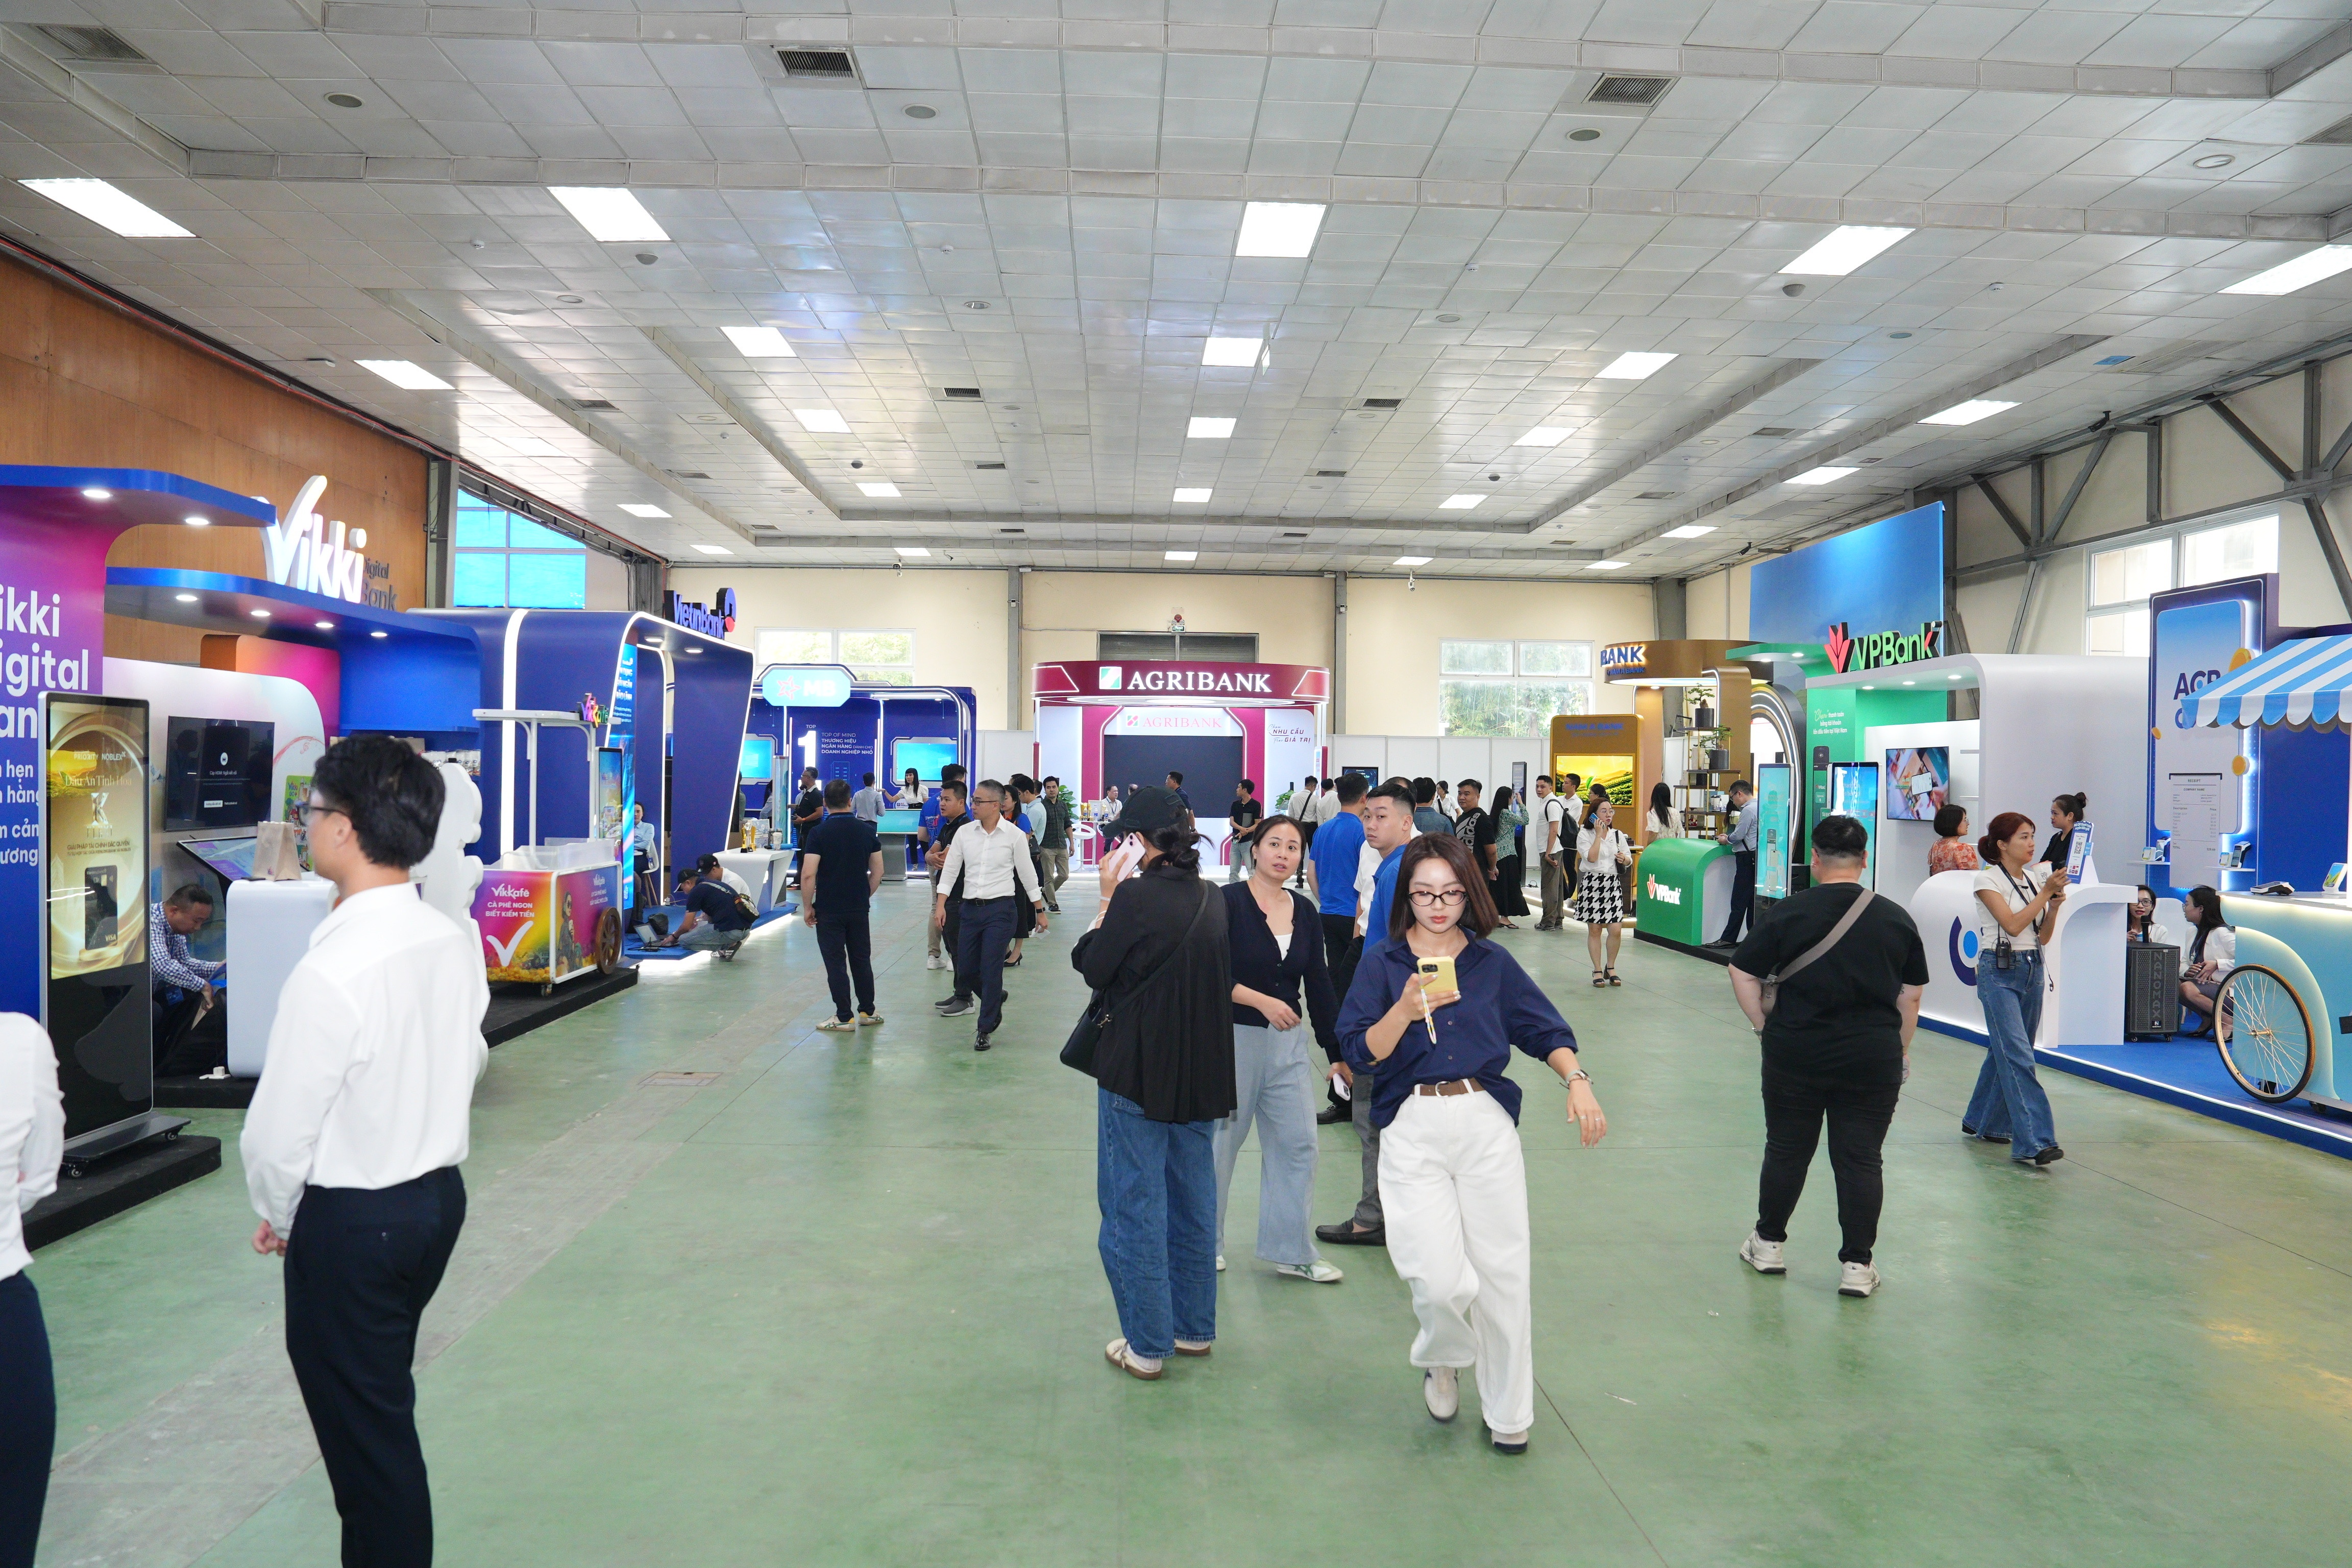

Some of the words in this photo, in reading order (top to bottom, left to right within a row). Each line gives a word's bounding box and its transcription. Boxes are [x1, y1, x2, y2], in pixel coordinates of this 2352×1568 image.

[257, 475, 366, 603] Vikki
[1601, 646, 1643, 667] BANK
[1854, 623, 1933, 670] VPBank
[803, 680, 836, 696] MB
[1127, 671, 1272, 692] AGRIBANK
[1142, 717, 1222, 727] AGRIBANK
[1656, 884, 1680, 905] VPBank
[502, 909, 518, 917] KIẾM
[2152, 952, 2162, 1018] NANOMAX
